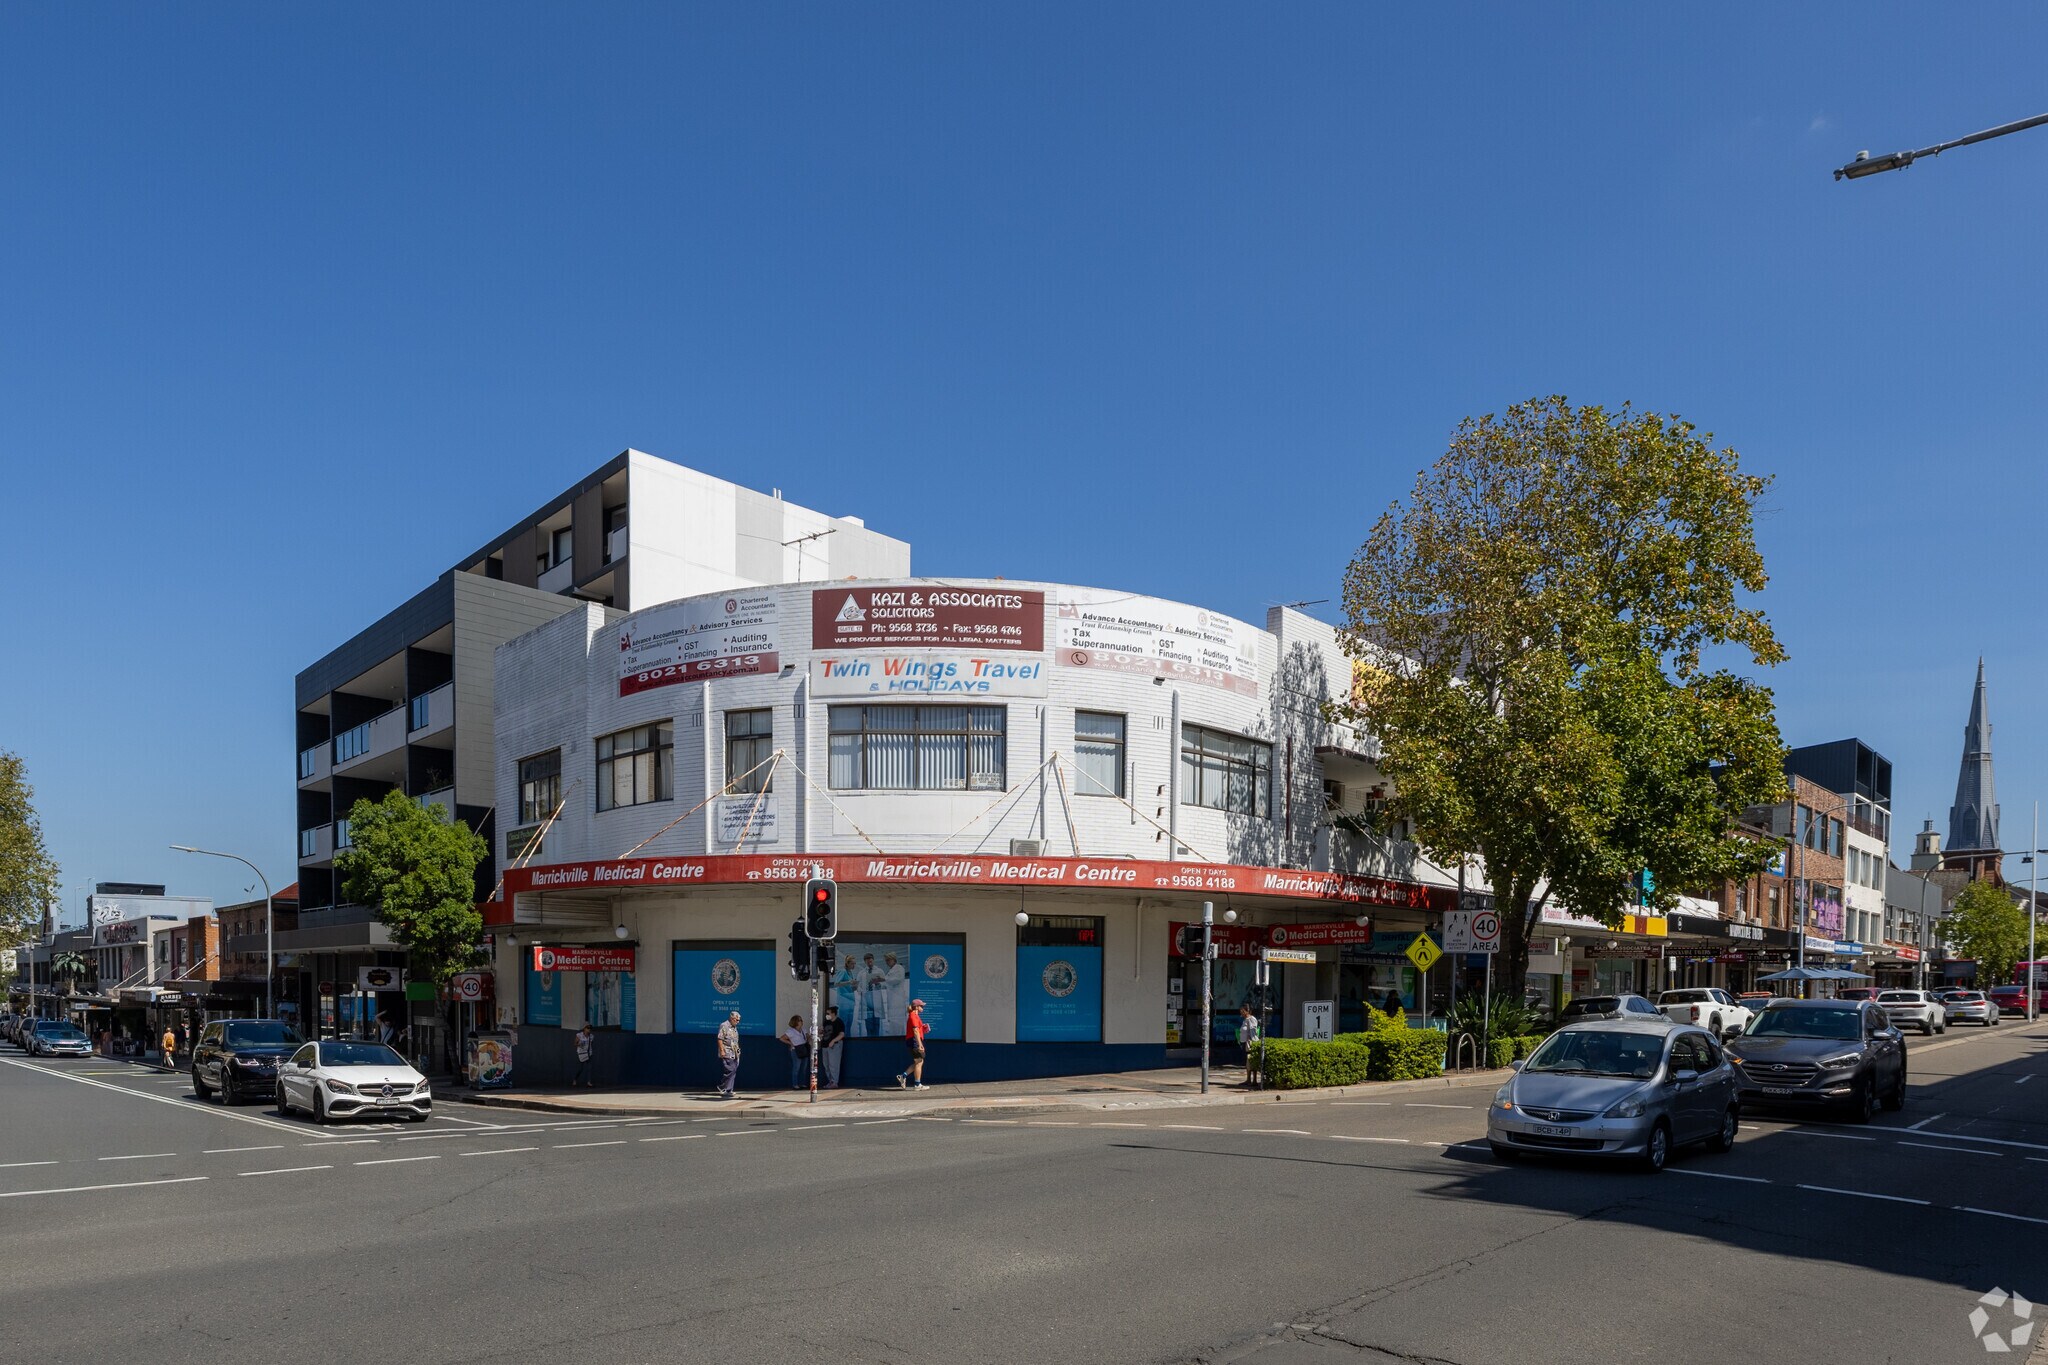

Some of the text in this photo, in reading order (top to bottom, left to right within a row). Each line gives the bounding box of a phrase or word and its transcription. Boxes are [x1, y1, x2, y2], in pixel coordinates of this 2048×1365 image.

[740, 596, 769, 604] Chartered
[871, 592, 1022, 609] KAZI & ASSOCIATES
[740, 603, 776, 611] Accountants
[871, 608, 935, 619] SOLICITORS
[632, 636, 651, 647] Advance
[652, 628, 689, 641] Accountancy
[699, 621, 729, 631] Advisory
[731, 617, 763, 626] Services
[872, 623, 886, 633] Ph:
[889, 623, 912, 632] 9568
[915, 623, 937, 632] 3736
[953, 624, 971, 633] Fax:
[974, 624, 998, 634] 9568
[1073, 628, 1091, 637] Tax
[1082, 613, 1116, 623] Advance
[1118, 617, 1164, 631] Accountancy
[1175, 626, 1202, 639] Advisory
[1203, 632, 1226, 645] Services
[730, 634, 767, 644] Auditing
[1159, 639, 1175, 648] GST
[684, 641, 699, 650] GST
[730, 642, 773, 654] Insurance
[1072, 638, 1143, 653] Superannuation
[627, 656, 637, 665] Tax
[684, 649, 718, 660] Financing
[1158, 649, 1192, 663] Financing
[1203, 648, 1229, 663] Auditing
[627, 657, 672, 674] Superannuation
[638, 656, 760, 682] 8021 6313
[821, 658, 1040, 680] Twin Wings Travel
[1093, 652, 1162, 668] 8021
[1172, 662, 1224, 681] 6313
[1202, 658, 1233, 672] Insurance
[869, 680, 990, 692] & HOLIDAYS
[531, 862, 705, 886] Marrickville Medical Centre
[764, 867, 834, 879] 9568 488
[866, 861, 1137, 881] Marrickville Medical Centre
[1172, 875, 1236, 888] 9568 4188
[1263, 873, 1408, 902] Marrickville Medical Centre
[1475, 919, 1496, 933] 40
[1289, 929, 1365, 940] Medical Centre
[1472, 942, 1499, 950] AREA
[556, 956, 631, 965] Medical Centre
[1269, 951, 1308, 960] MARRICKVILLE
[464, 982, 479, 992] 40
[1307, 1005, 1329, 1013] FORM
[1315, 1015, 1321, 1029] 1
[1307, 1031, 1329, 1039] LANE
